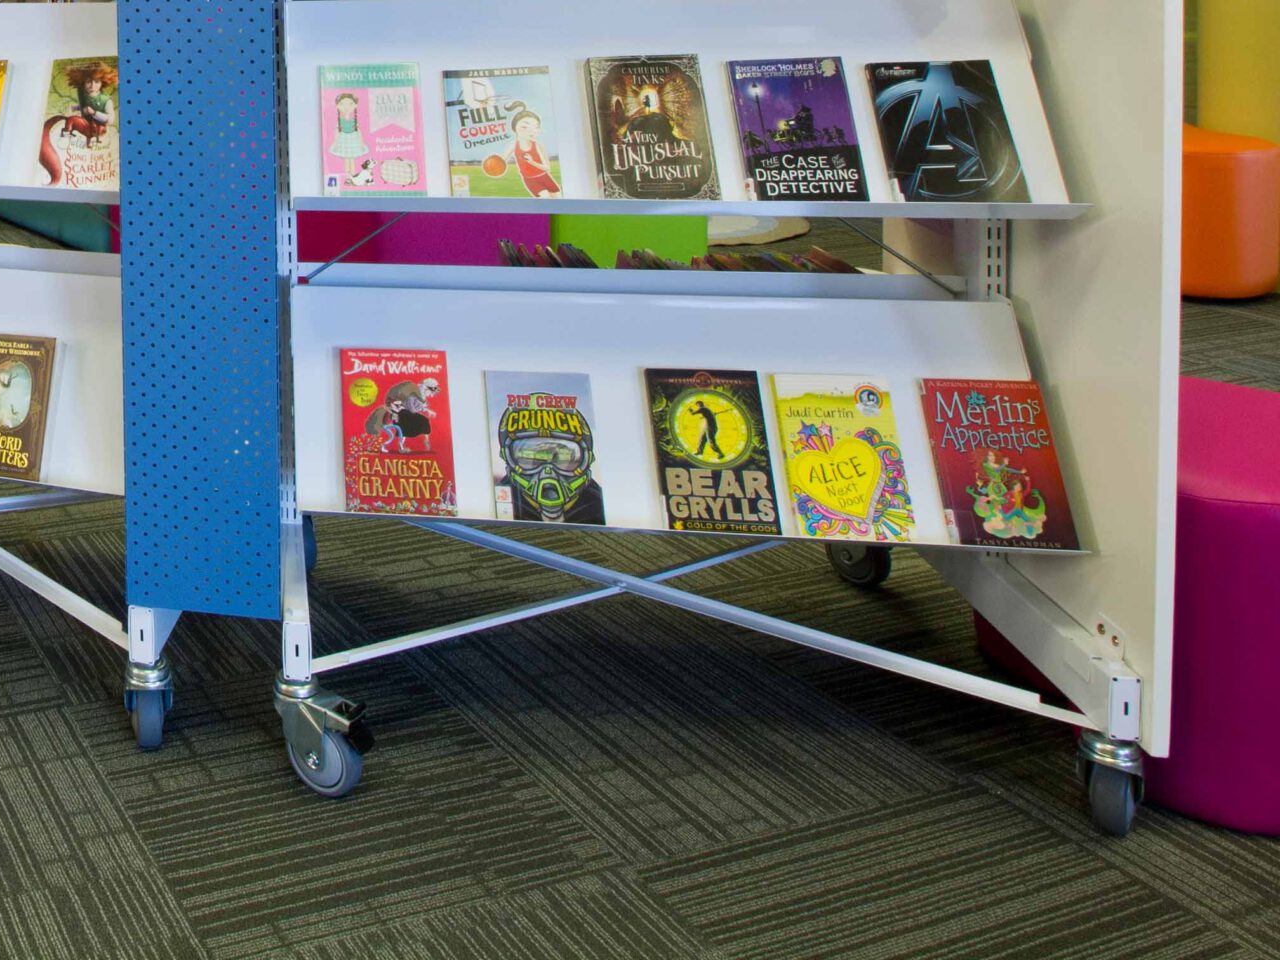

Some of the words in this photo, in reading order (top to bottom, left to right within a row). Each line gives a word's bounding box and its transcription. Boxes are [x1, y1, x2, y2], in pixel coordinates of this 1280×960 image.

[324, 71, 364, 80] WENDY
[368, 70, 417, 80] HARMER
[735, 64, 777, 73] SHERLOCK
[779, 63, 814, 71] HOLMES
[458, 105, 507, 127] FULL
[459, 123, 507, 139] COURT
[464, 133, 512, 150] Dreams
[611, 140, 703, 171] UNUSUAL
[760, 156, 779, 168] THE
[782, 154, 830, 169] CASE
[64, 159, 113, 175] SCARLET
[634, 164, 702, 182] PURSUIT
[755, 167, 859, 182] DISAPPEARING
[64, 170, 117, 188] RUNNER
[766, 181, 857, 196] DETECTIVE
[344, 358, 386, 376] David
[387, 360, 442, 375] Walliams
[507, 394, 531, 407] PIT
[536, 395, 577, 409] CREW
[935, 391, 1041, 427] Merlin's
[786, 407, 811, 418] Judi
[815, 408, 854, 419] Curtin
[507, 410, 583, 436] CRUNCH
[940, 422, 1050, 454] Apprentice
[359, 457, 444, 478] GANGSTA
[359, 476, 444, 500] GRANNY
[665, 467, 772, 500] BEAR
[826, 481, 859, 498] Next
[669, 495, 776, 522] GRYLLS
[838, 494, 866, 509] Door
[751, 525, 778, 533] GODS
